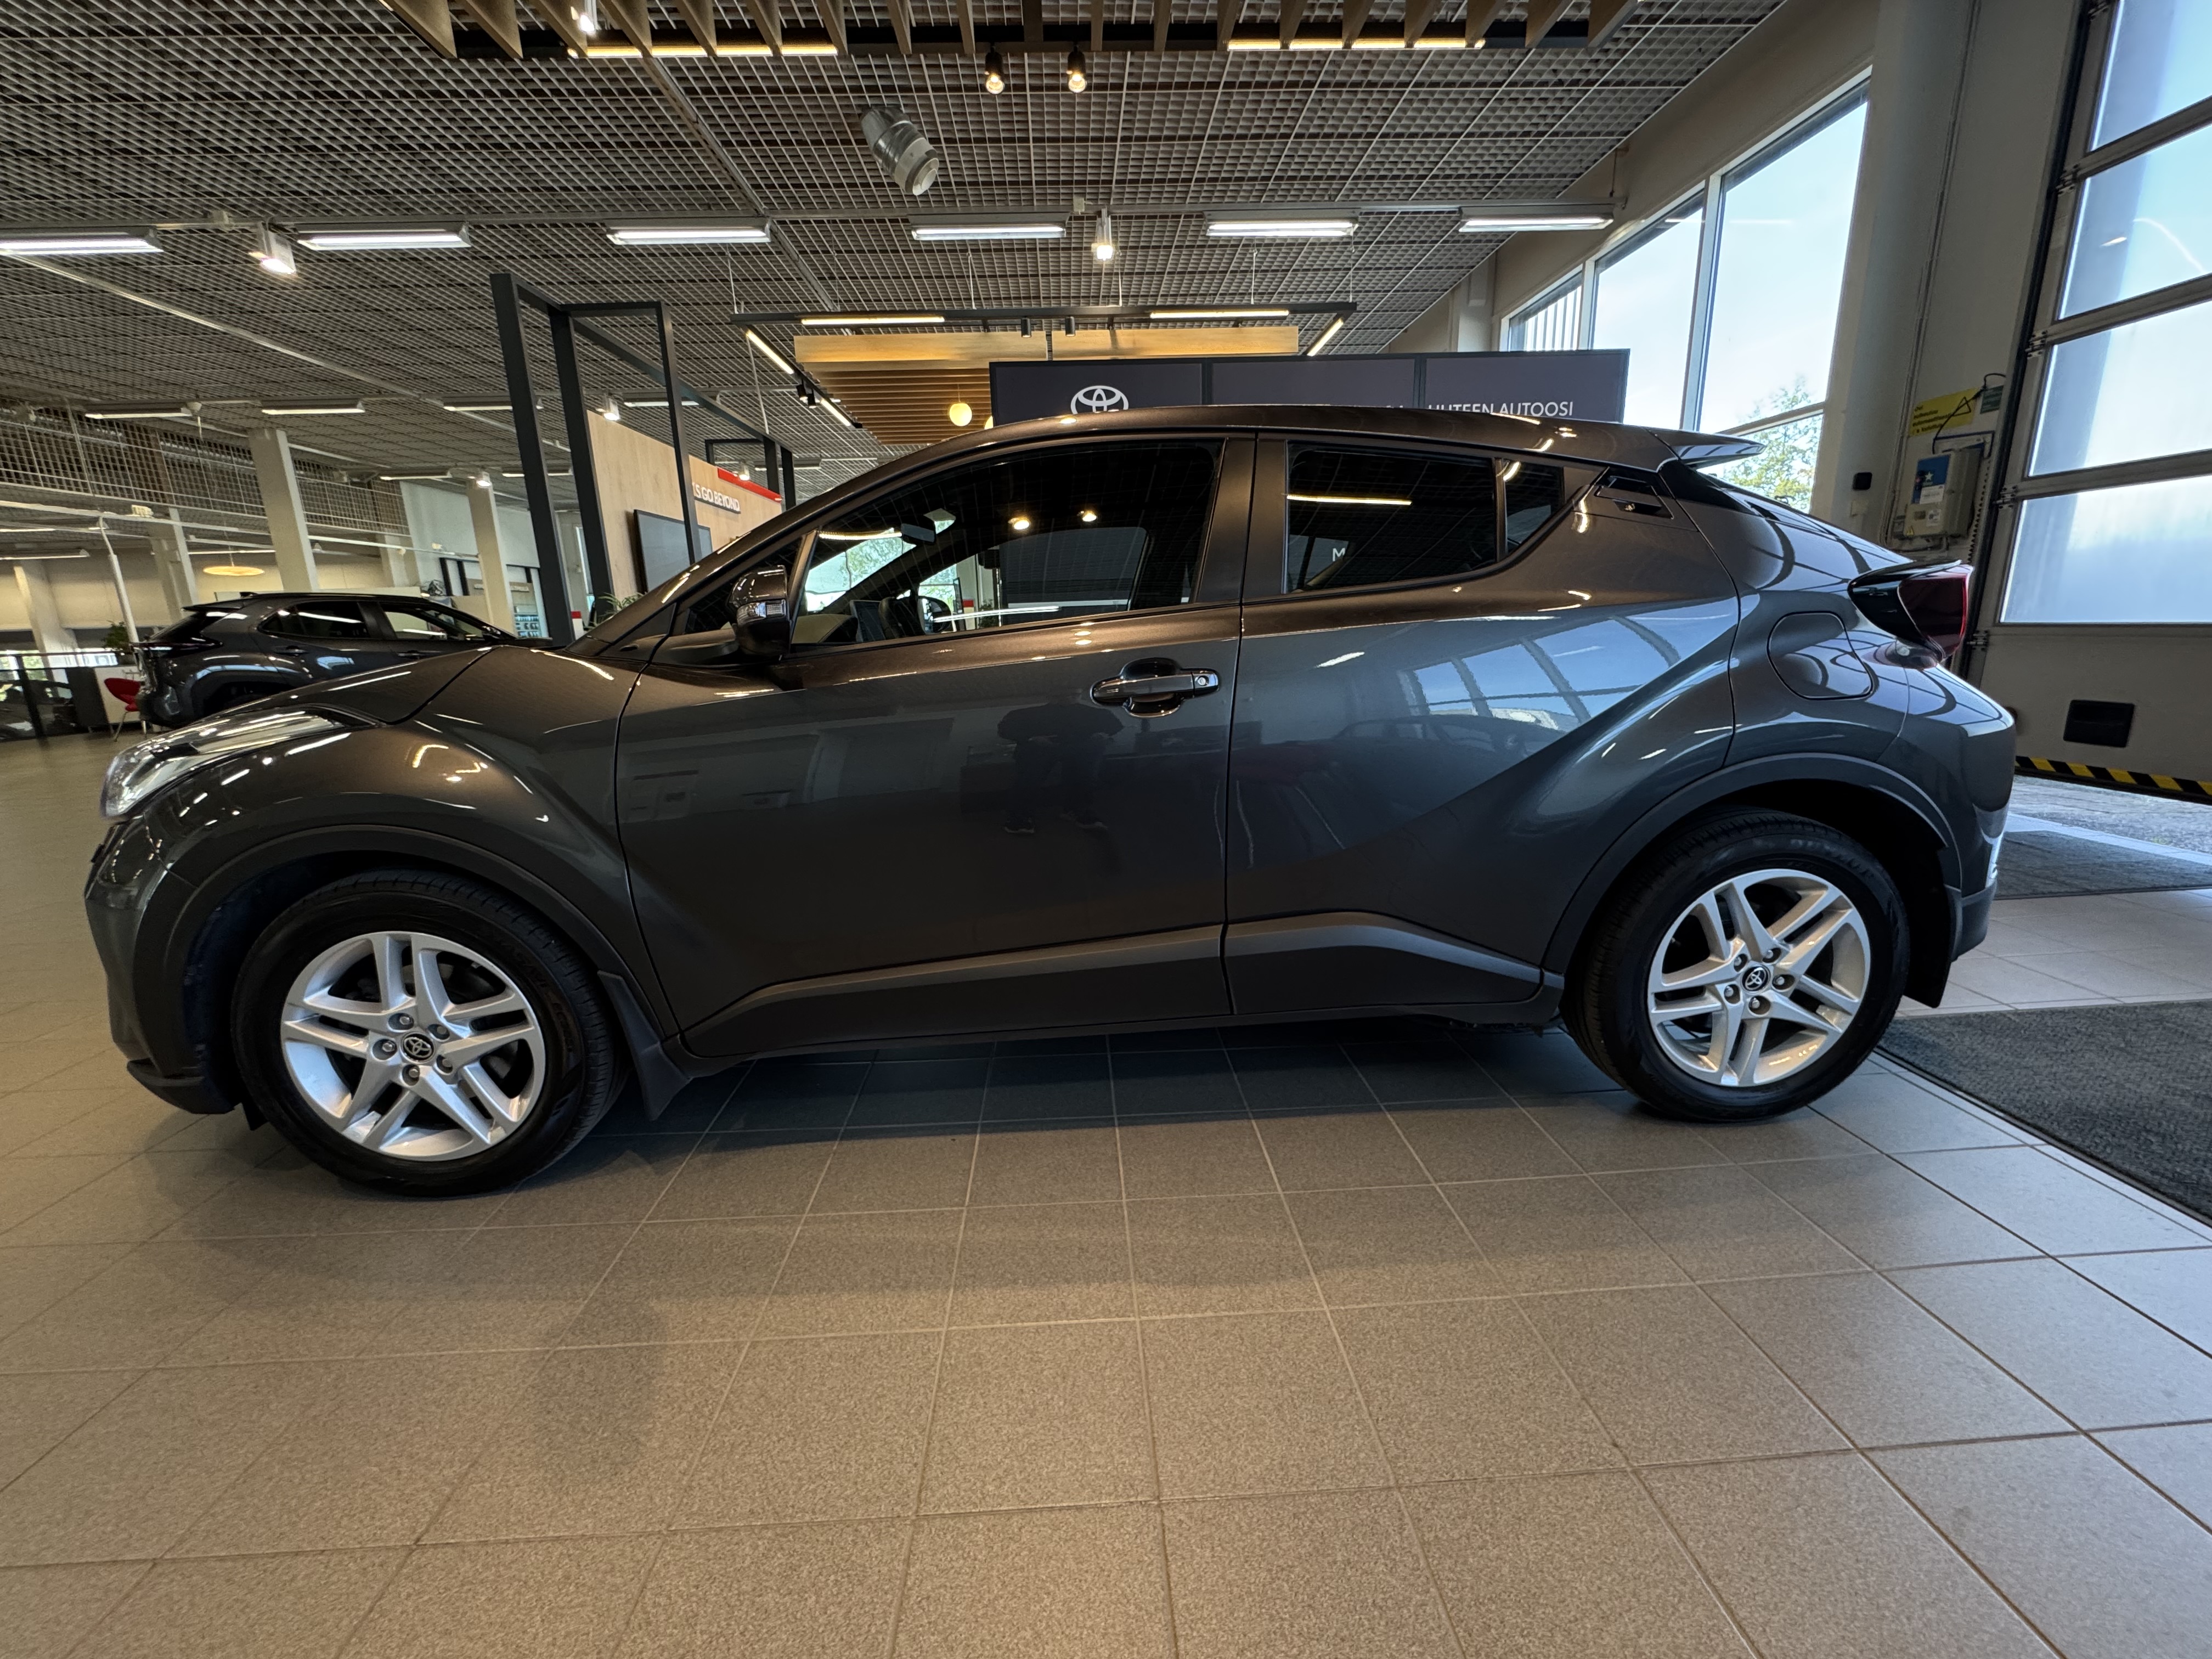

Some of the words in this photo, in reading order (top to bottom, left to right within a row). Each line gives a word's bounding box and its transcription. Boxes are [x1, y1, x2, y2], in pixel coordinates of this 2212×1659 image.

[1499, 401, 1573, 416] AUTOOSI
[702, 487, 714, 503] GO
[714, 490, 740, 512] BEYOND
